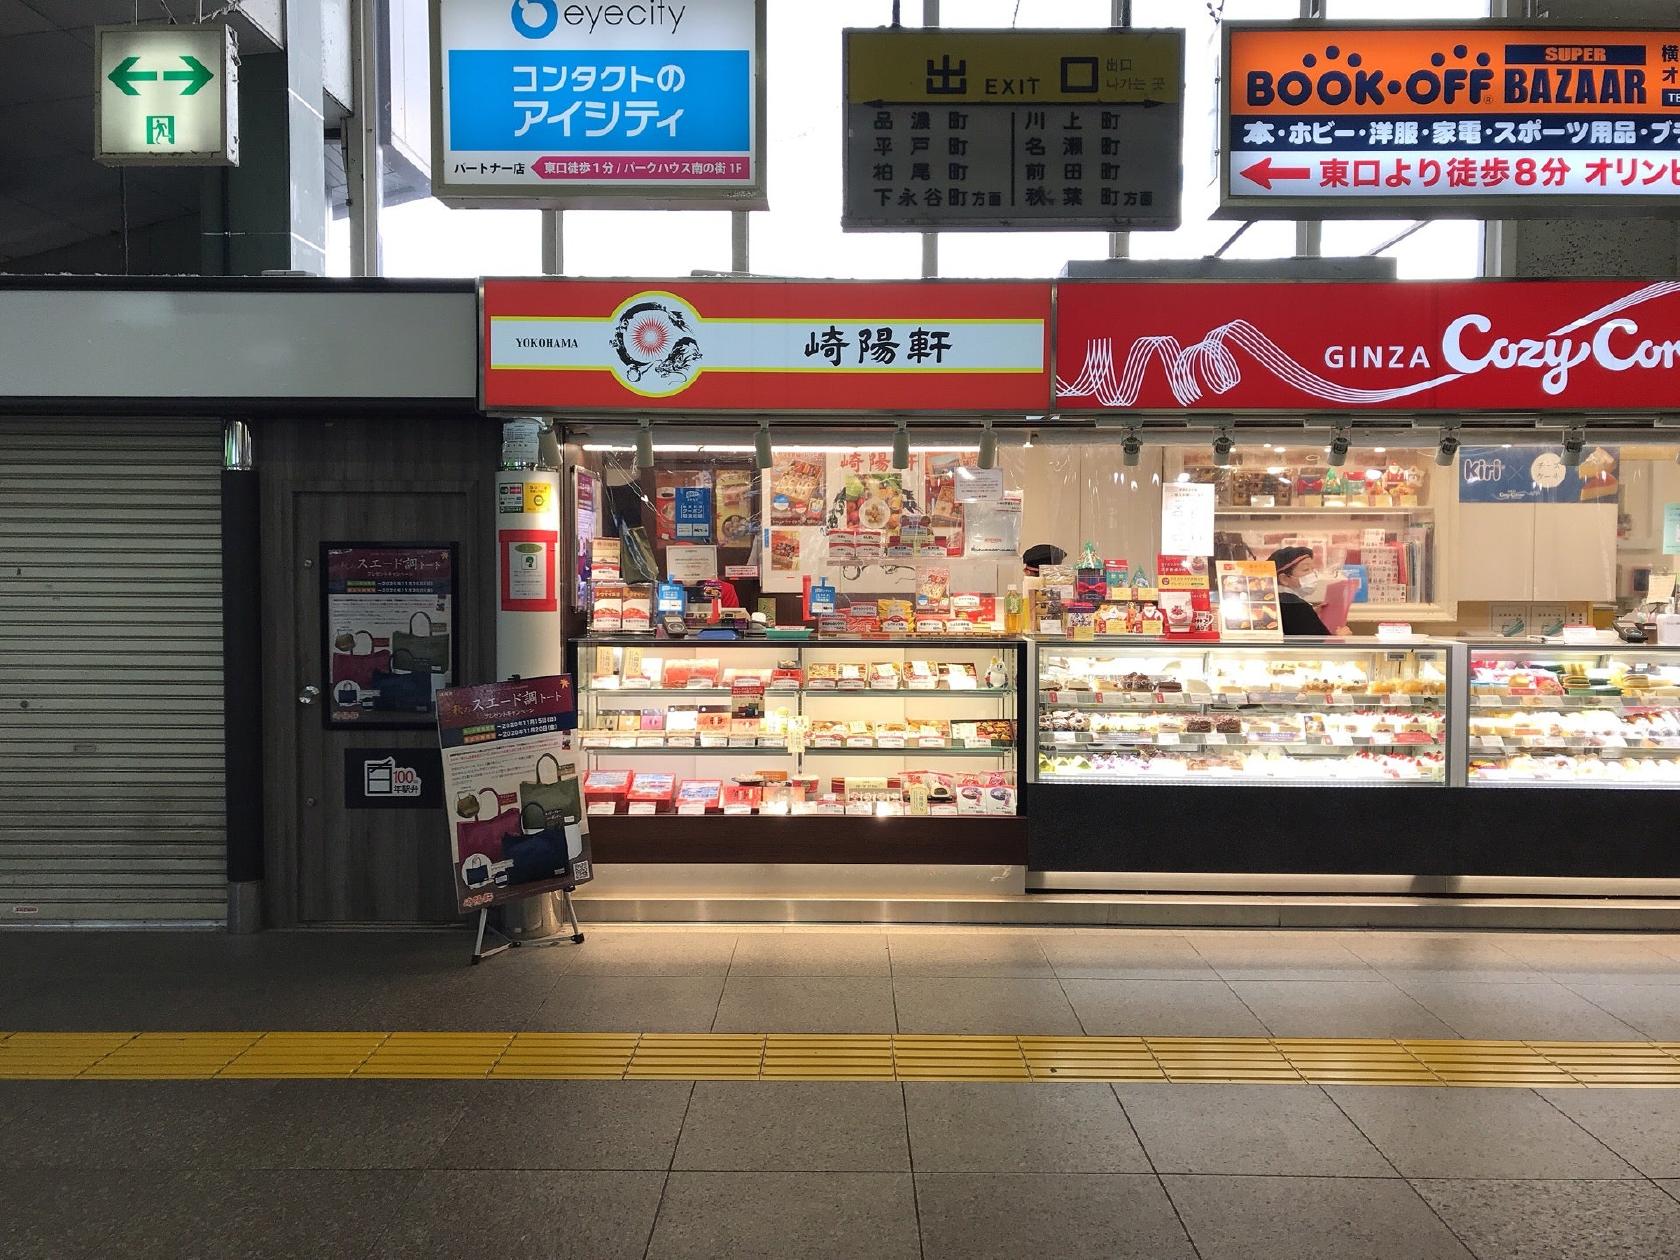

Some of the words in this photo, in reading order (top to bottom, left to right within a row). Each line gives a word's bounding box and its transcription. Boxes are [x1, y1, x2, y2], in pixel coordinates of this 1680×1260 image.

[564, 0, 686, 34] eyecity
[1106, 58, 1132, 72] 出口
[1545, 47, 1607, 62] SUPER
[512, 64, 686, 93] コンタクトの
[985, 77, 1040, 95] EXIT
[1504, 68, 1647, 104] BAZAAR
[513, 100, 685, 137] アイシティ
[1025, 111, 1120, 130] 川上町
[454, 162, 525, 175] パートナー店
[1025, 162, 1120, 181] 前田町
[1319, 157, 1572, 188] 東口より徒歩8分
[515, 337, 579, 349] YOKOHAMA
[803, 324, 953, 367] 崎陽軒
[1323, 345, 1431, 369] GINZA
[1442, 313, 1592, 395] Cozy
[1464, 458, 1502, 481] Kiri
[392, 770, 414, 783] 100
